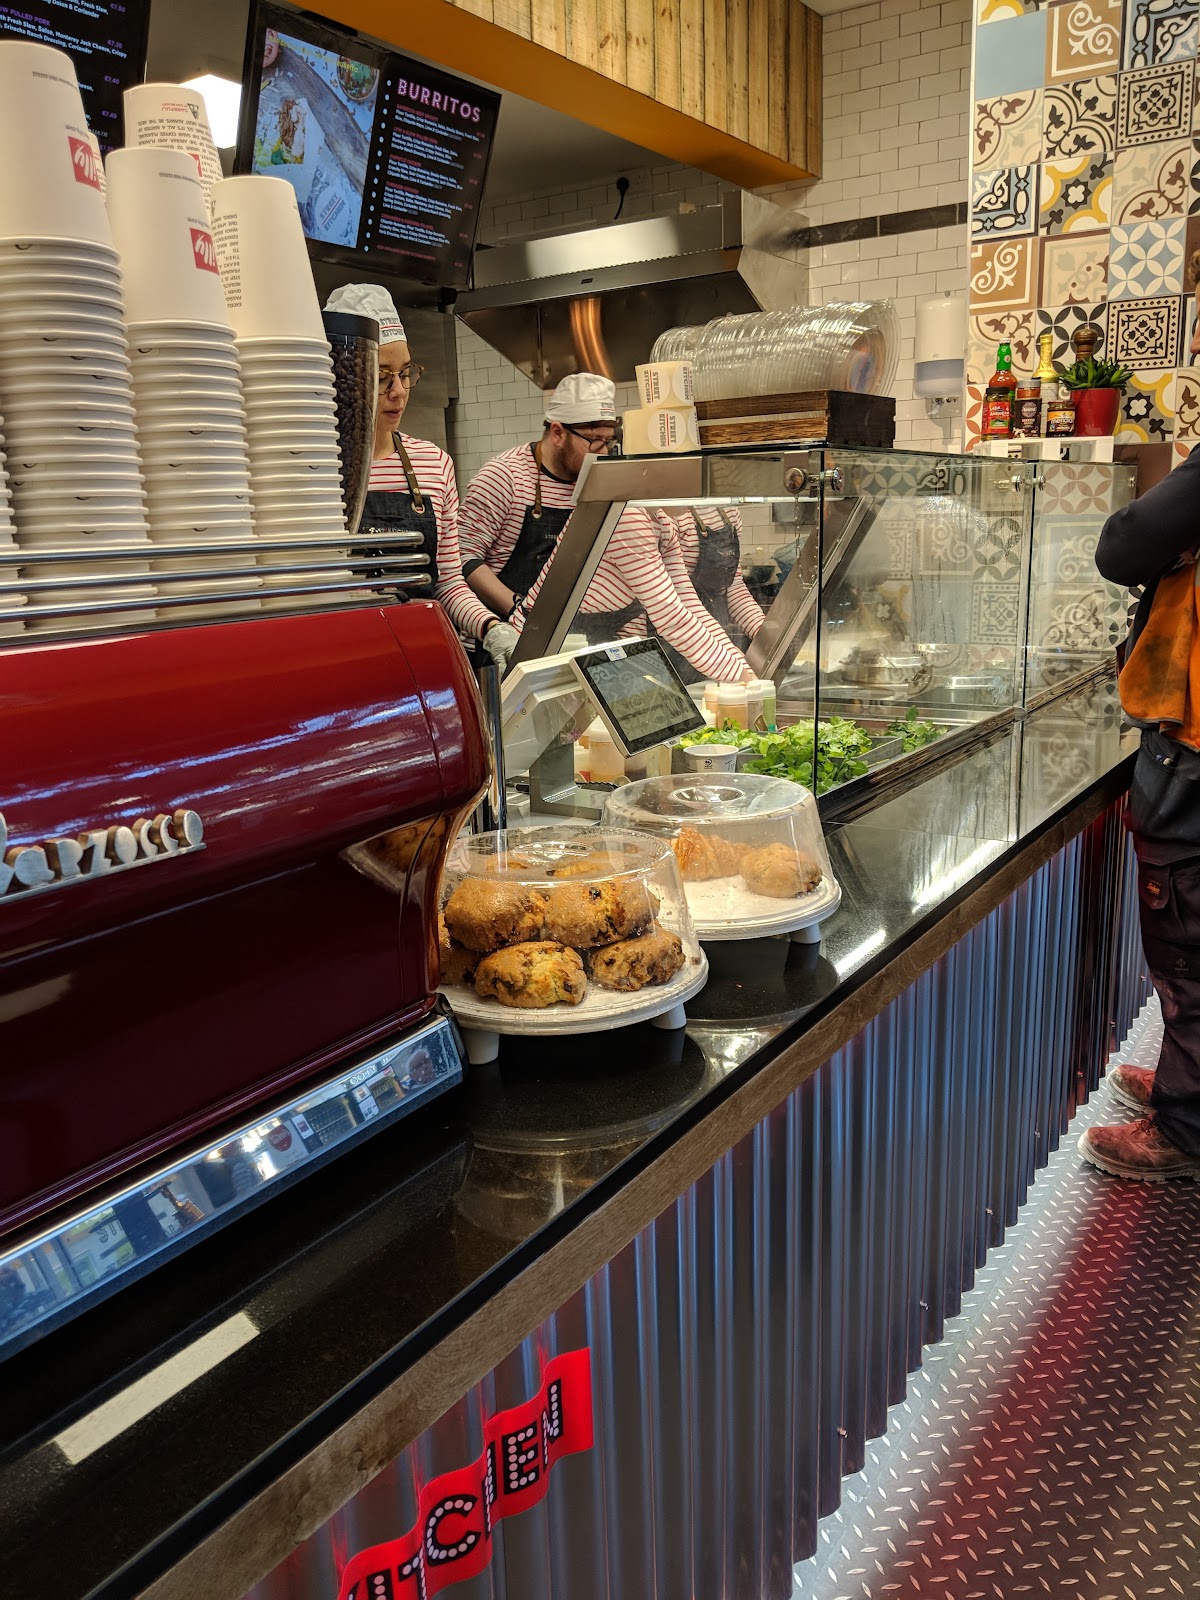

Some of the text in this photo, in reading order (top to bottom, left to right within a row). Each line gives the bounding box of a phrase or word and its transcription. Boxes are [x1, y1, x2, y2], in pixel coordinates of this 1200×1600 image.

[7, 17, 22, 26] Fresh
[10, 9, 33, 20] PULLED
[34, 16, 51, 26] PORK
[397, 78, 481, 122] BURRITOS
[73, 145, 97, 183] illy
[195, 235, 216, 267] illy
[644, 370, 652, 404] KITCHEN
[652, 371, 660, 400] STREET
[682, 367, 690, 400] KITCHEN
[669, 416, 677, 444] STREET
